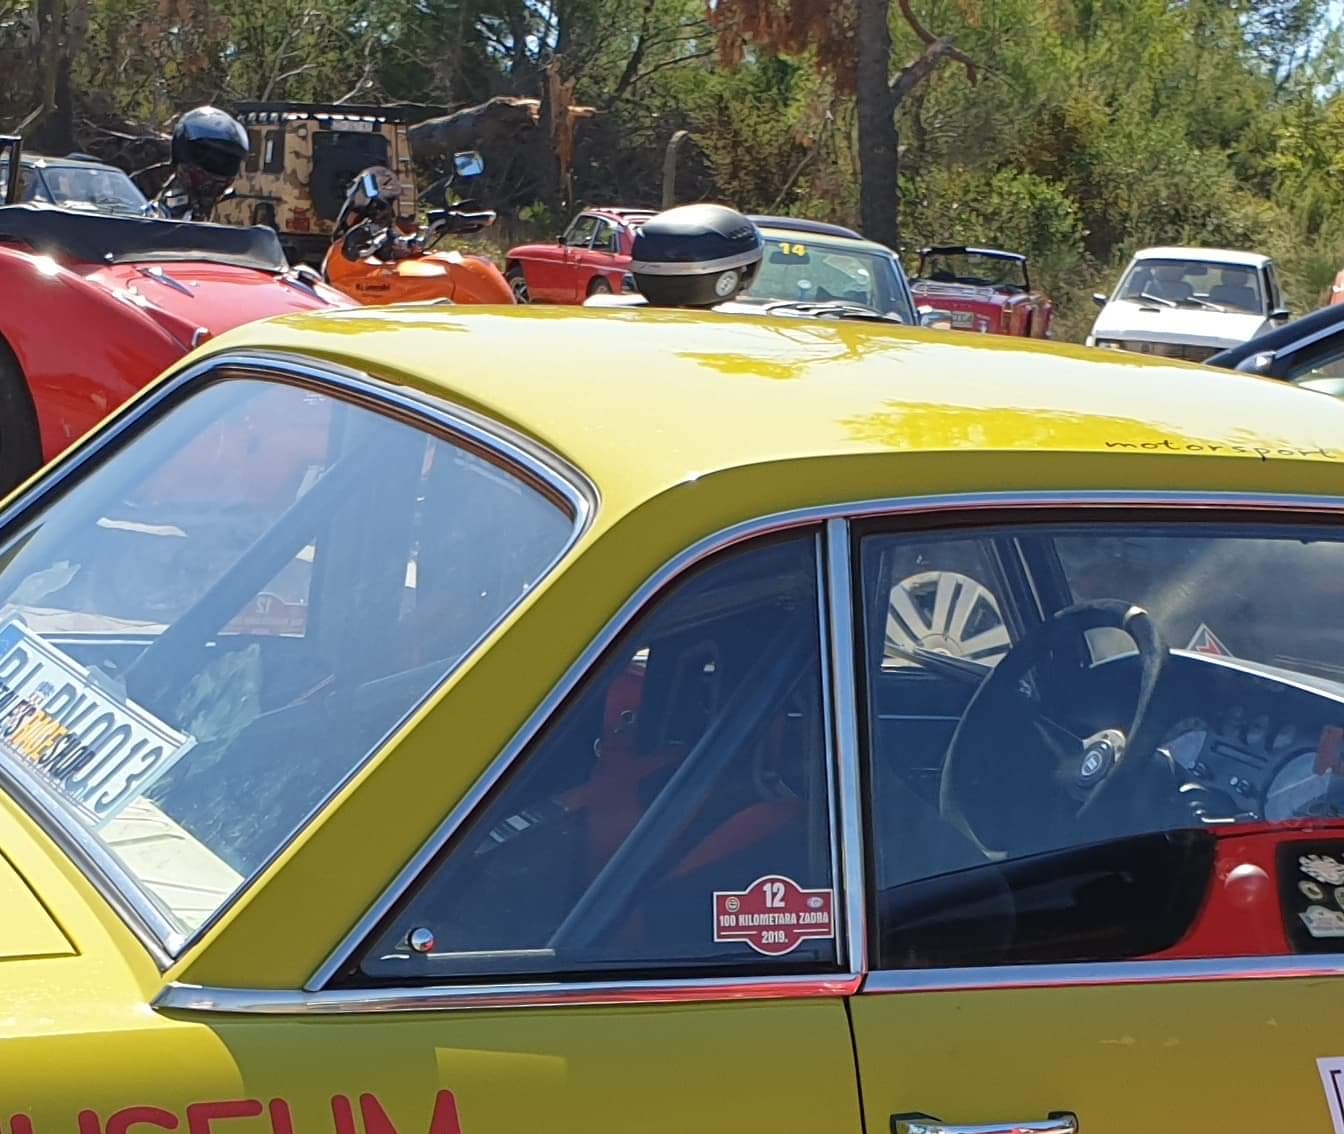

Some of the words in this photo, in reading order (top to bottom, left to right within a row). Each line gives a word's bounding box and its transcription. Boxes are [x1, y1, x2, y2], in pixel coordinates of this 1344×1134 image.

[779, 242, 806, 256] 14
[1105, 439, 1337, 462] motorsport
[763, 882, 786, 908] 12
[720, 914, 736, 927] 100
[761, 930, 789, 944] 2019.
